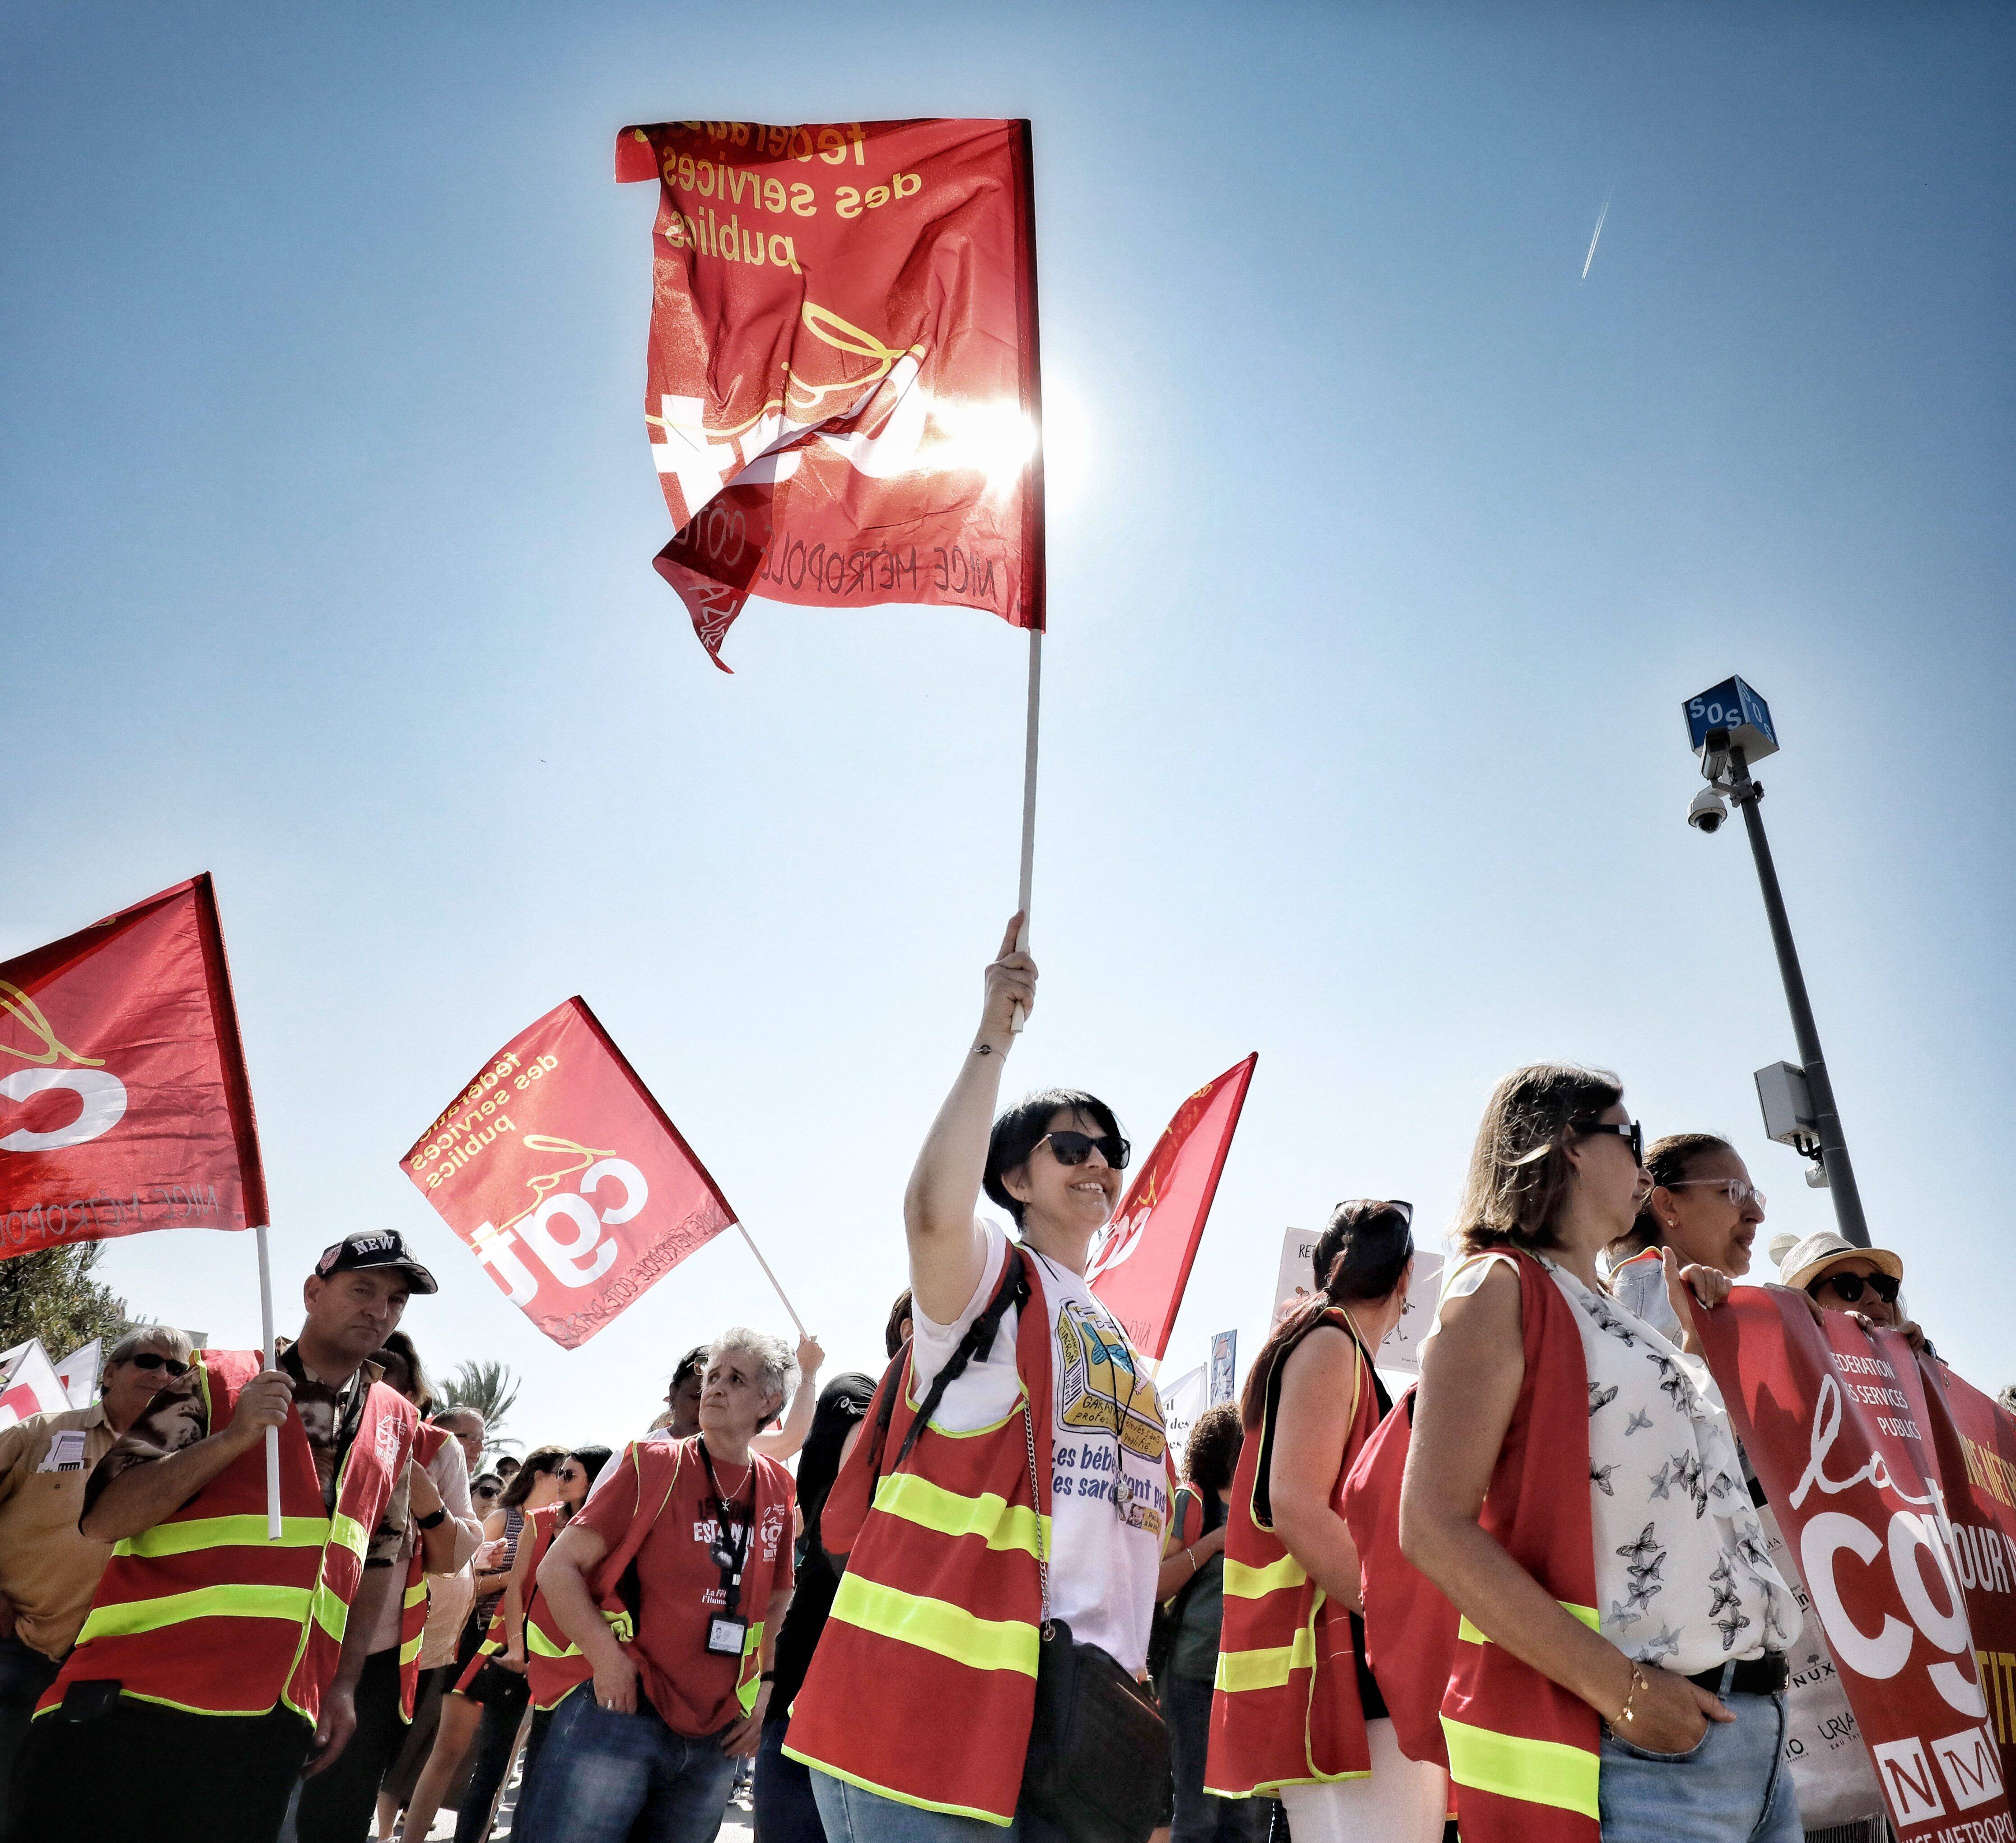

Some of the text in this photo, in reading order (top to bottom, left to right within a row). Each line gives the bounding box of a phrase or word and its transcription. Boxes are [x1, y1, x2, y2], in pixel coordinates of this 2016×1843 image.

[1689, 697, 1742, 730] SOS
[351, 1237, 395, 1255] NEW
[1059, 1326, 1076, 1364] MACRON
[1856, 1385, 1909, 1409] SERVICES
[1170, 1417, 1189, 1430] des
[1876, 1416, 1922, 1440] PUBLICS
[693, 1520, 718, 1544] EST
[1951, 1522, 2011, 1594] OUR
[1792, 1662, 1836, 1688] NUX
[1830, 1740, 1844, 1750] EAU
